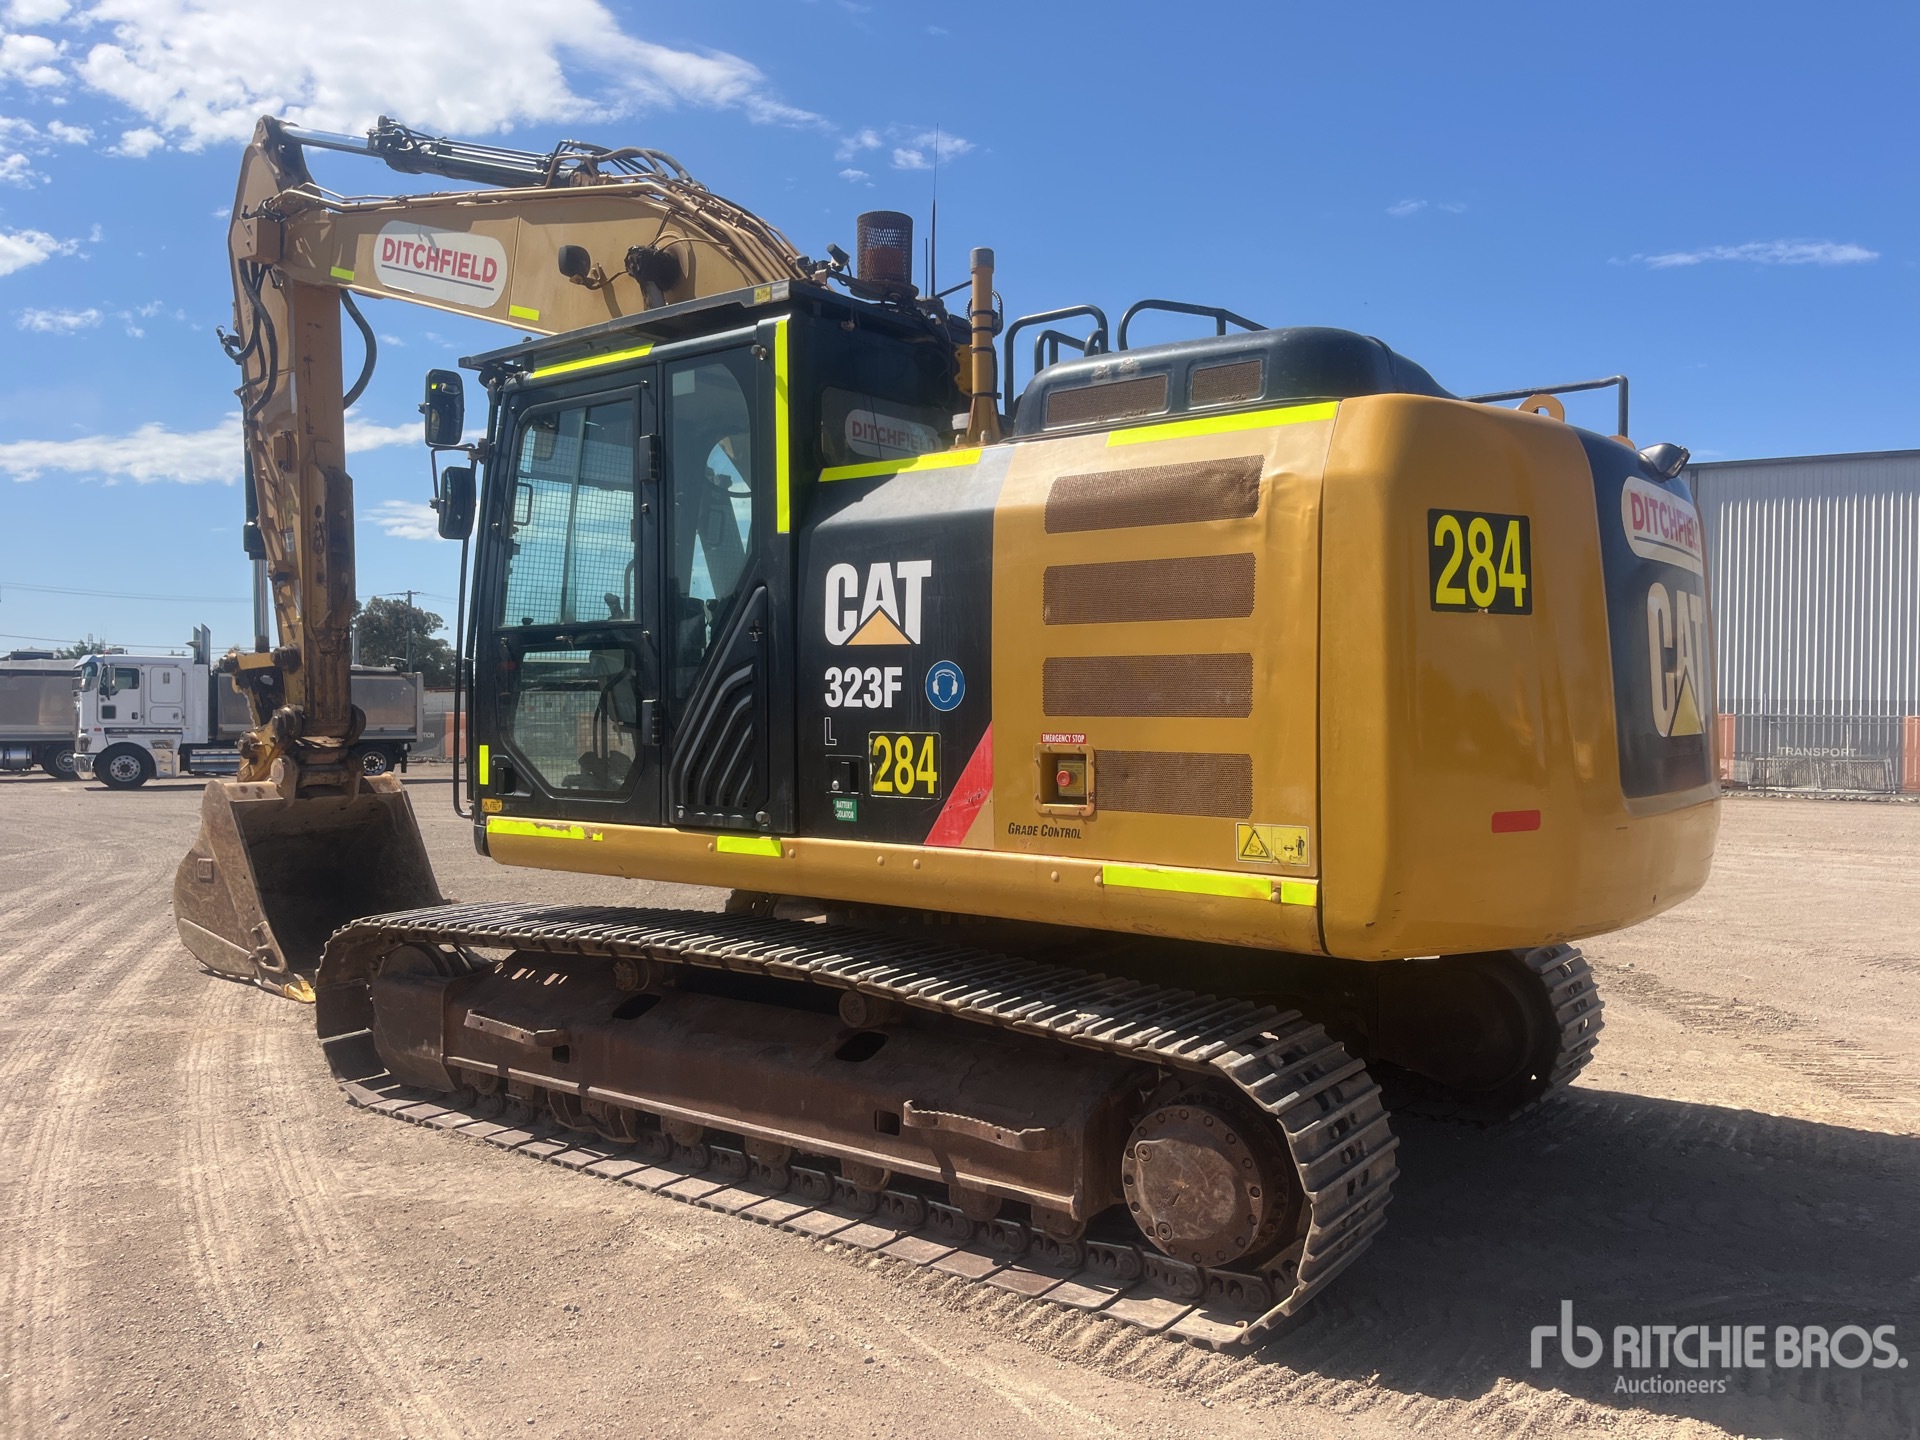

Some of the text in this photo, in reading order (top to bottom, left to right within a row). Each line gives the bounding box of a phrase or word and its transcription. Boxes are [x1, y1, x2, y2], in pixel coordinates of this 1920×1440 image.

[382, 237, 498, 283] DITCHFIELD
[1434, 514, 1526, 608] 284
[825, 560, 932, 645] CAT
[1647, 582, 1706, 737] CAT
[824, 666, 903, 709] 323F
[824, 717, 837, 745] L
[1042, 733, 1085, 743] EMERGENCY STOP
[872, 735, 938, 794] 284
[1778, 746, 1857, 758] TRANSPORT
[835, 810, 855, 819] SOLATOR
[836, 800, 853, 809] BATTERY
[1008, 822, 1082, 839] GRADE CONTROL
